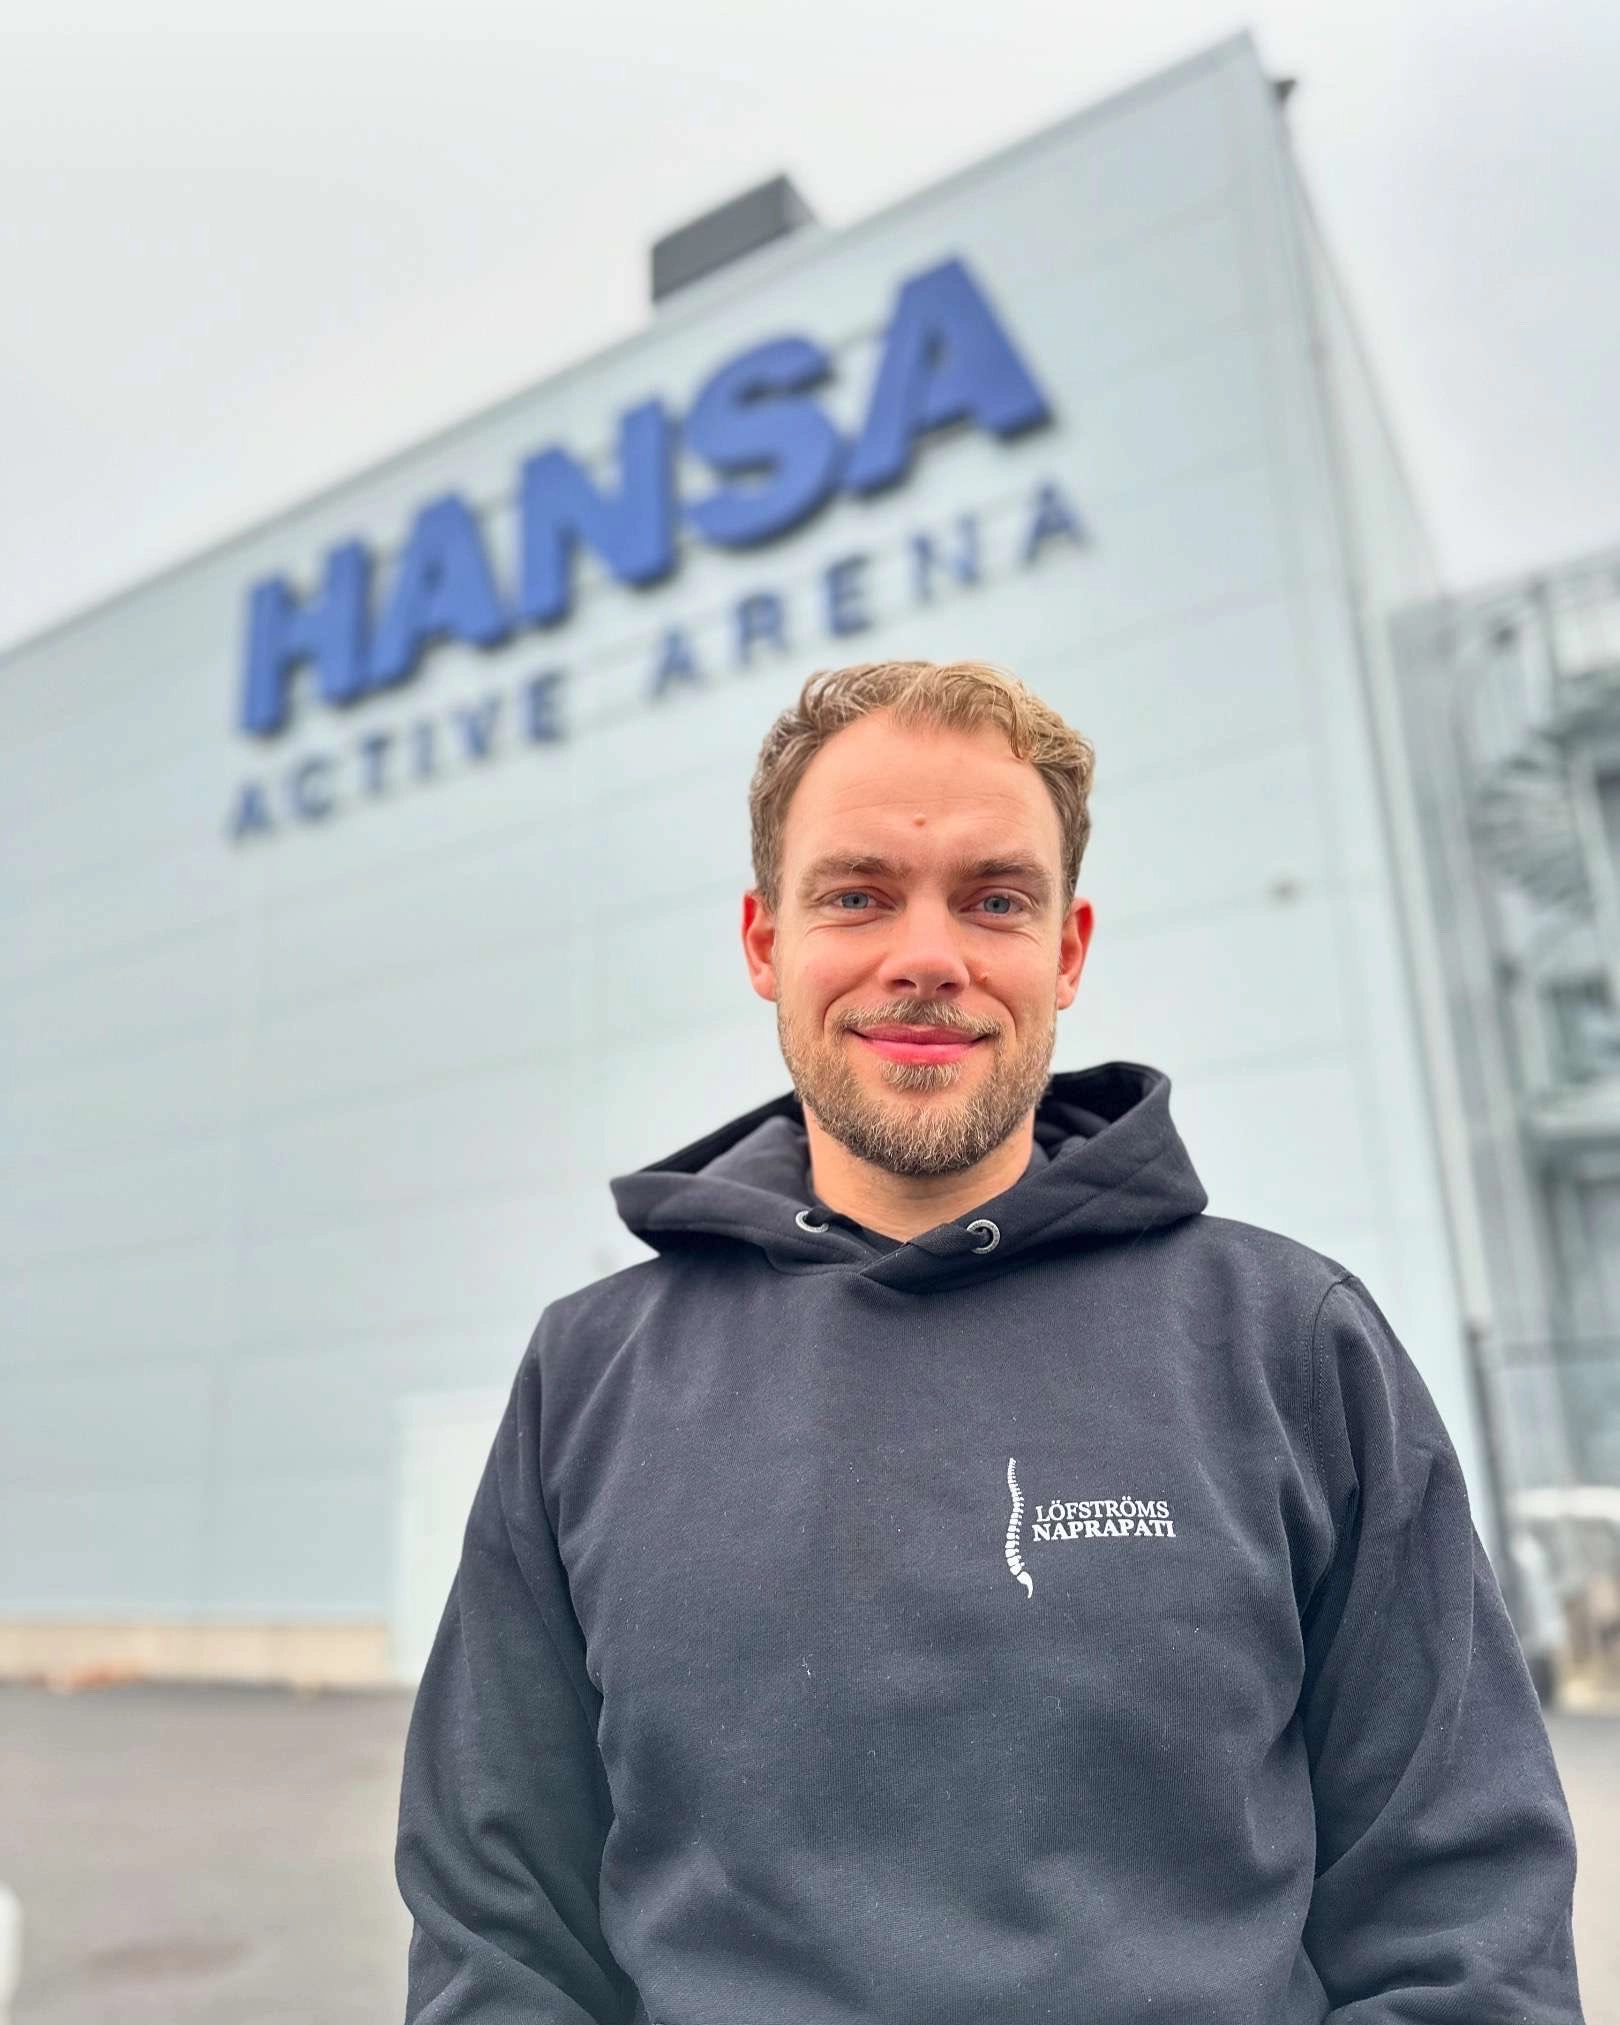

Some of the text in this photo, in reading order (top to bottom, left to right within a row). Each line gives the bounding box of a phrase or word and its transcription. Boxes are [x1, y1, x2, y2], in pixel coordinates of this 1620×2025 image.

[237, 252, 1056, 738] HANSA
[229, 477, 1091, 844] ACTIVE ARENA
[1031, 1518, 1176, 1541] NAPRAPATI
[1035, 1495, 1170, 1522] LÖFSTRÖMS
